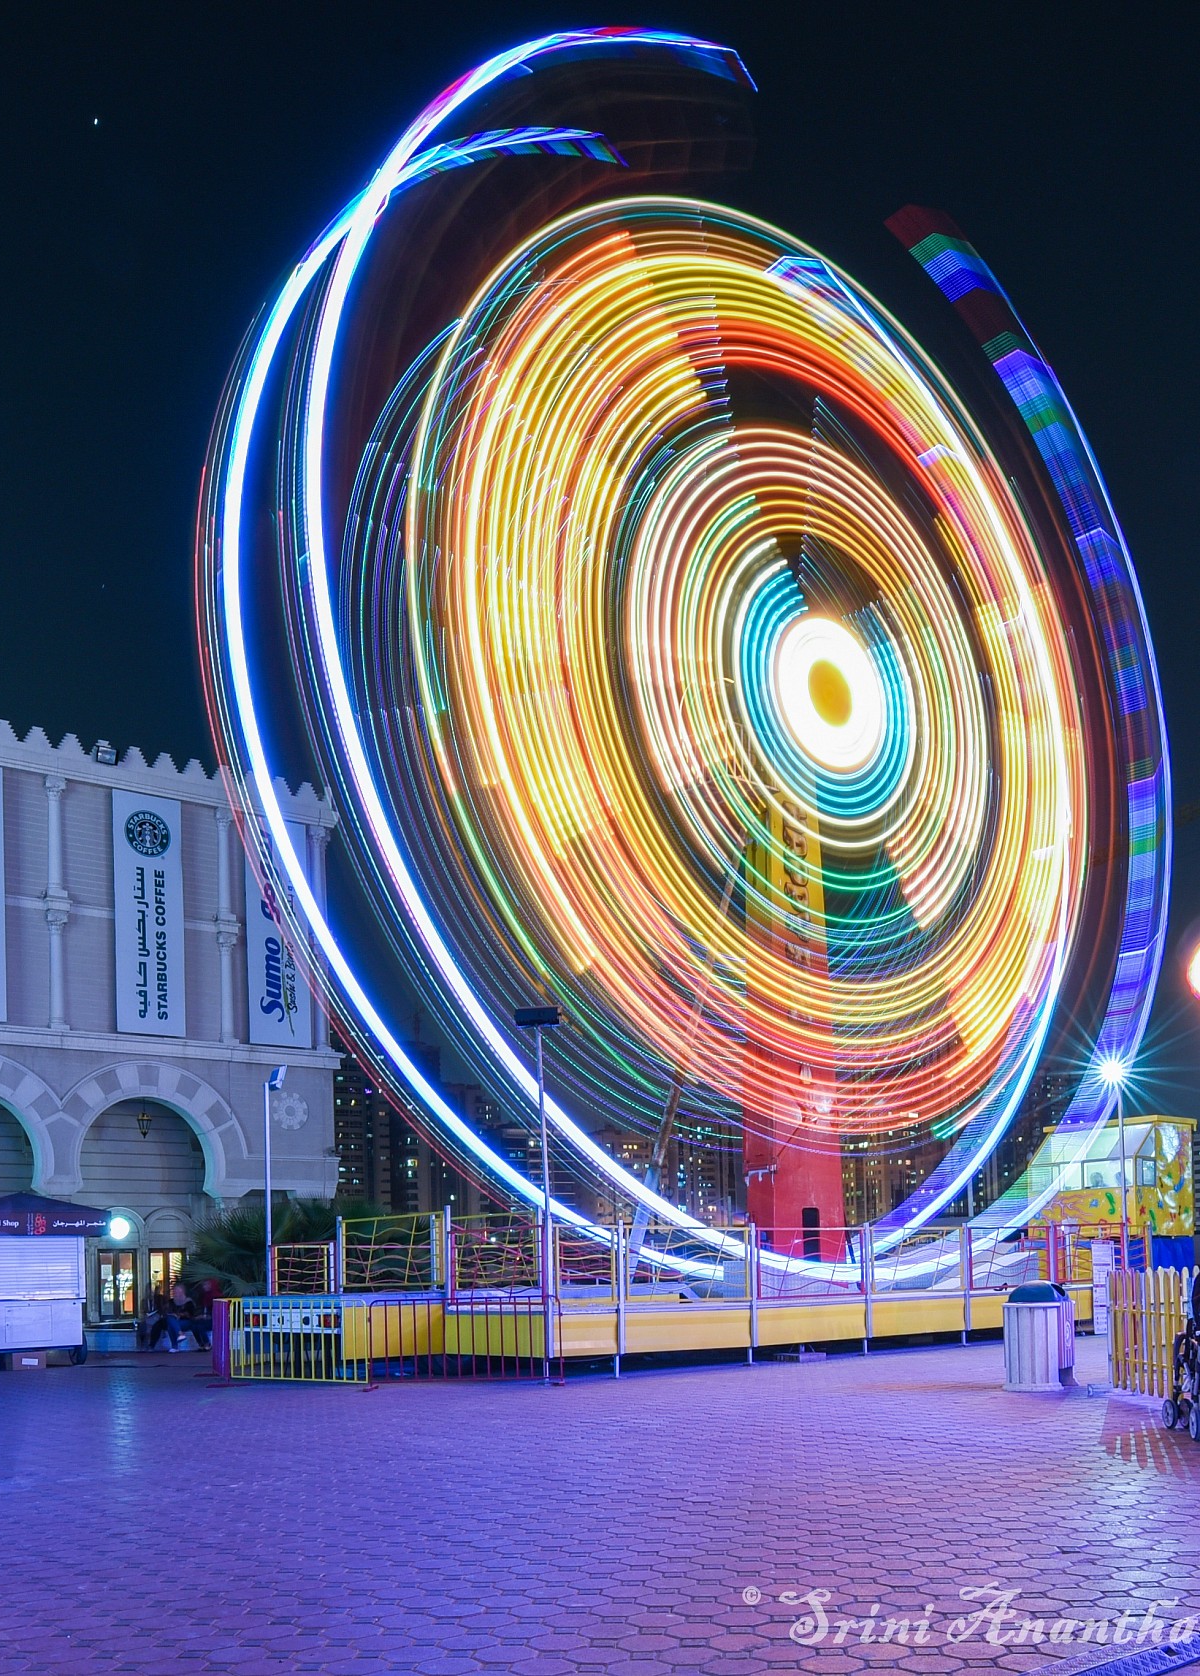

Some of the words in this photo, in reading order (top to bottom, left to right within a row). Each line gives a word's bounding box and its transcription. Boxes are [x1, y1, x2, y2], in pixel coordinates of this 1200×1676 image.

[127, 813, 168, 835] STARBUCKS
[132, 841, 164, 855] COFFEE
[154, 869, 167, 926] COFFEE
[134, 866, 151, 957] ستاربكس
[155, 931, 168, 1021] STARBUCKS
[260, 936, 285, 1023] Sumo
[286, 973, 296, 983] &
[136, 961, 151, 1019] كافيه
[285, 983, 298, 1014] Sushi
[2, 1219, 20, 1228] Shop
[52, 1219, 85, 1229] المهرجان
[85, 1219, 107, 1229] متجر
